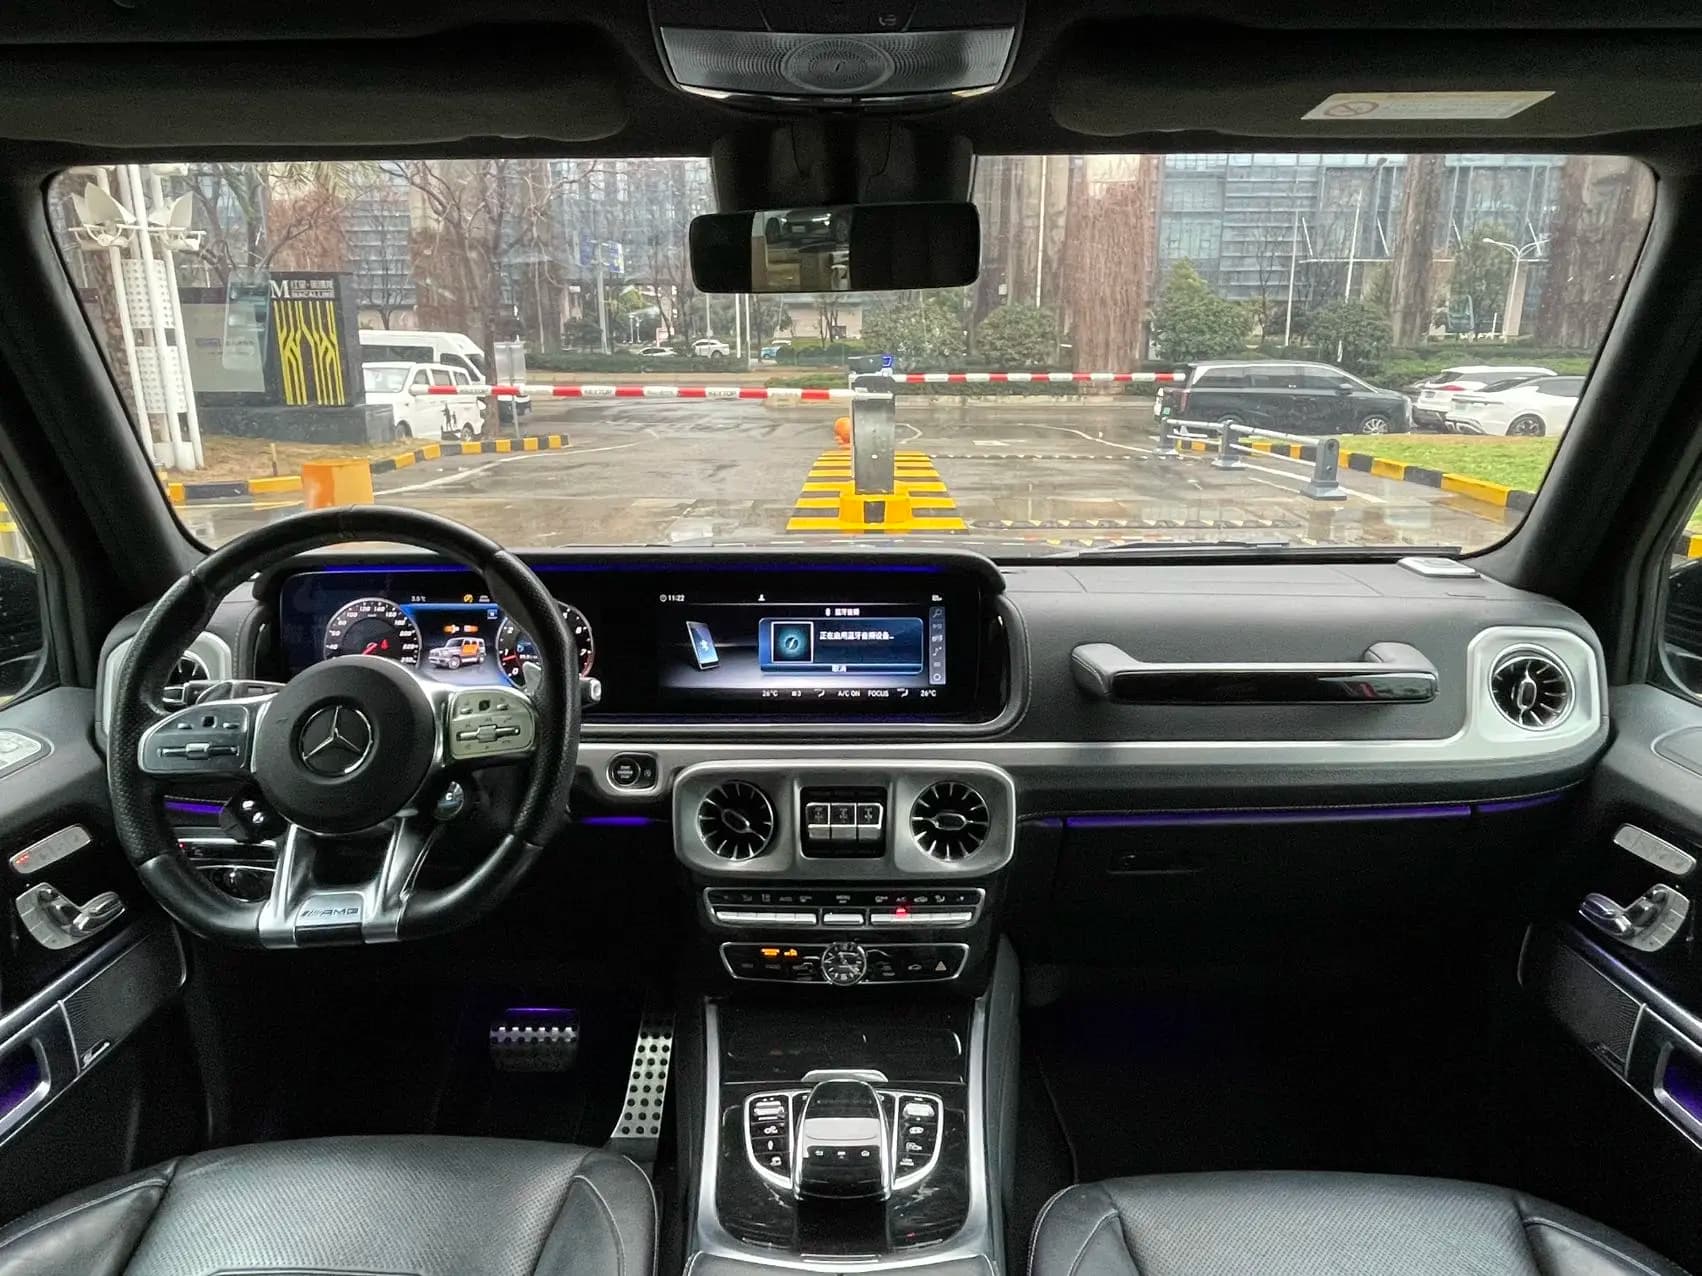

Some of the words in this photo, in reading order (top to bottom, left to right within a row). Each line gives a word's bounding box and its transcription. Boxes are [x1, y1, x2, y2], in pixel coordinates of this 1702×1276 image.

[269, 280, 290, 298] M
[851, 689, 861, 697] ON
[867, 689, 890, 697] FOCUS
[319, 908, 359, 917] AMG
